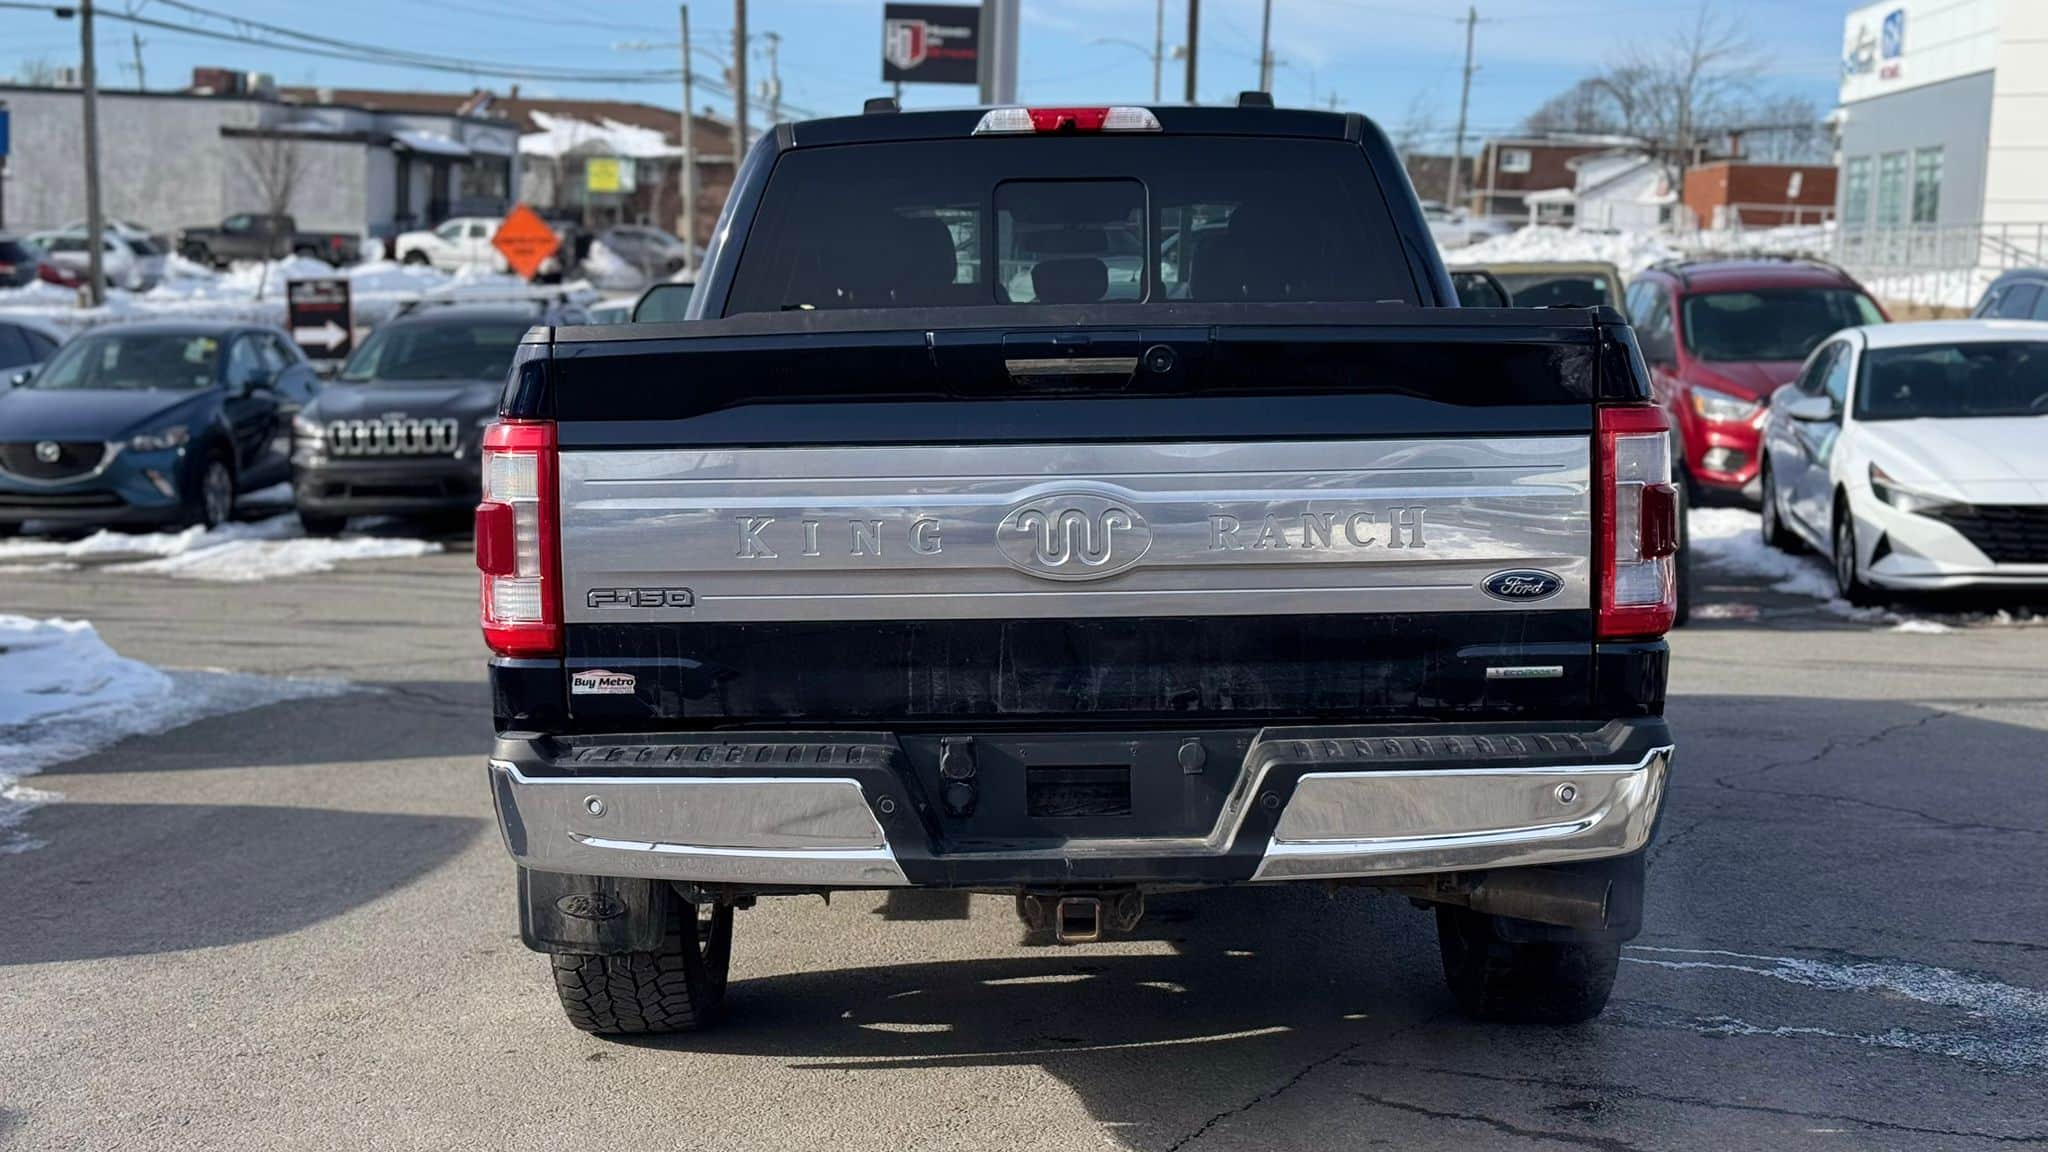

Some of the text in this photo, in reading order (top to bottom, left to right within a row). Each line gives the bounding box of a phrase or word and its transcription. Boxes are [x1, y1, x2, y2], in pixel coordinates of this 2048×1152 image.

[735, 505, 1427, 558] KING RANCH
[1500, 576, 1545, 594] Ford
[587, 587, 695, 608] F-150
[574, 677, 634, 689] Buy Metro
